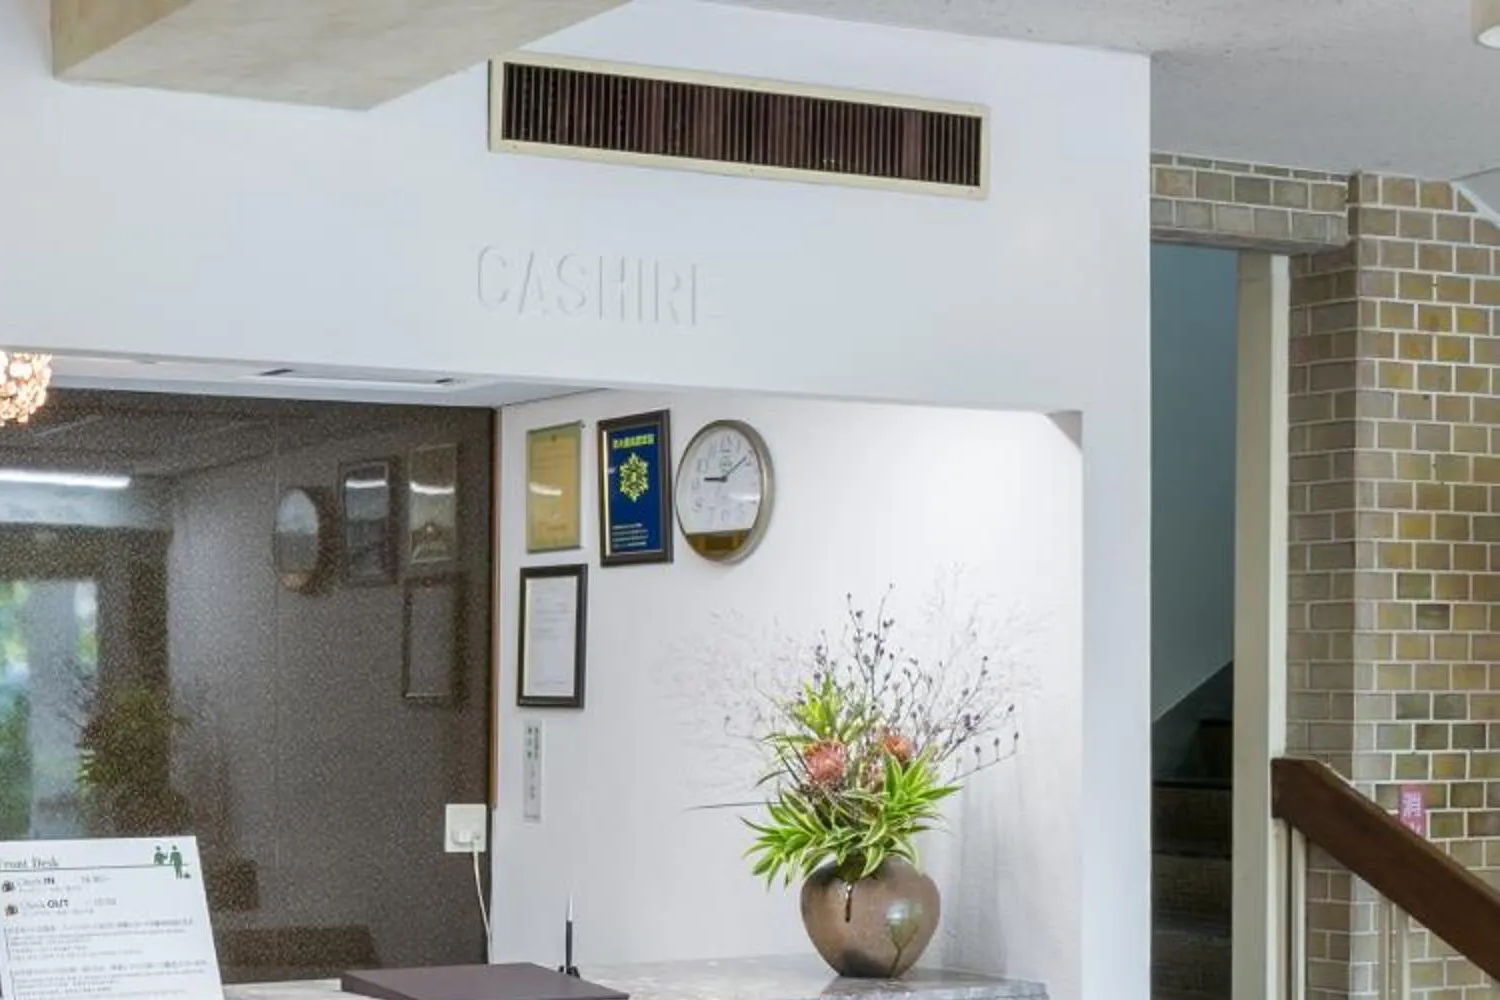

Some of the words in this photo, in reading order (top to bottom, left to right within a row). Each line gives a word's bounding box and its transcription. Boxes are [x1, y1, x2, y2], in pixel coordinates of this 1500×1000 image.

[31, 855, 59, 870] Desk
[43, 877, 55, 885] IN
[46, 899, 68, 908] OUT
